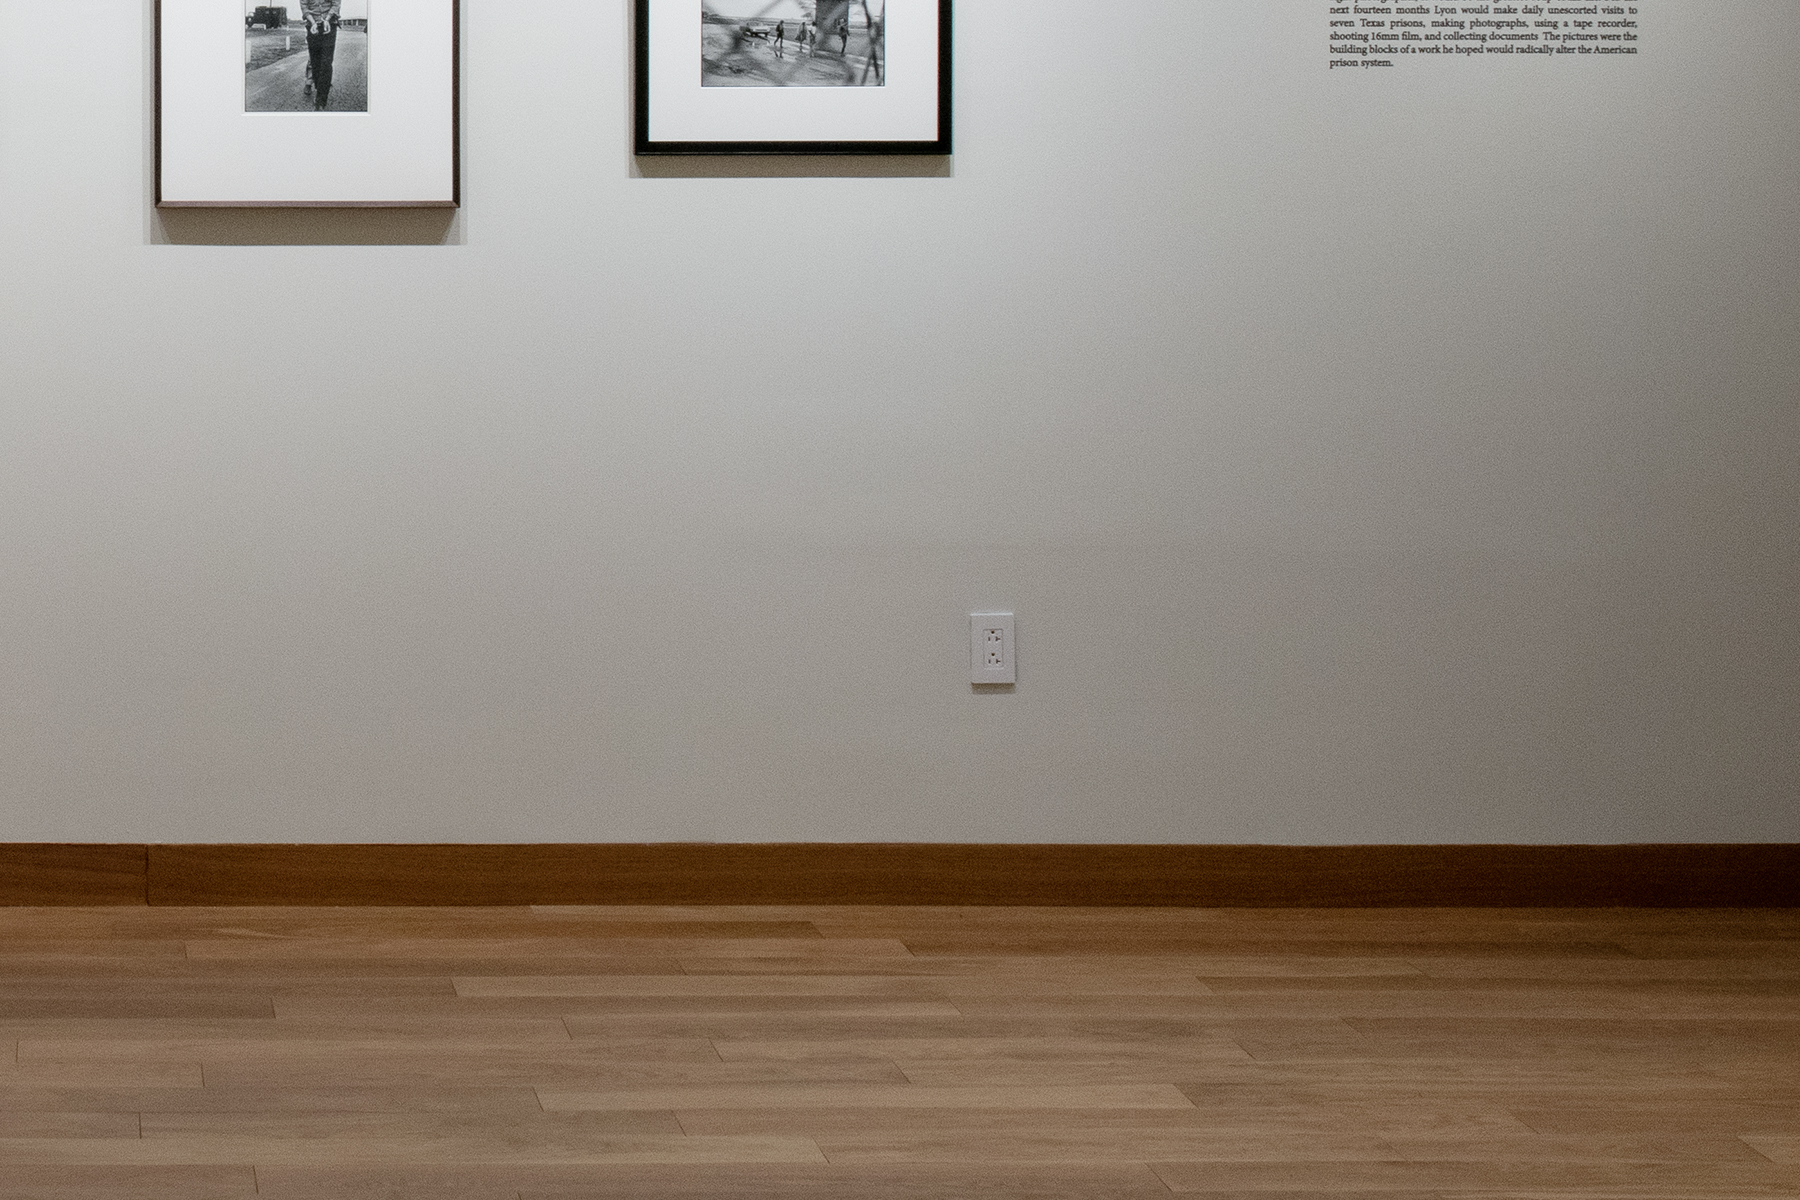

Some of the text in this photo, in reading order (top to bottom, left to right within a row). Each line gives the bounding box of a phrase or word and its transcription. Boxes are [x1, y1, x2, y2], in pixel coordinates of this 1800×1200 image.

[1329, 4, 1639, 17] next fourteen months Lyon would make daily unescorted visits to
[1329, 20, 1356, 28] seven
[1359, 17, 1386, 28] Texas
[1389, 18, 1426, 31] prisons,
[1430, 17, 1466, 31] making
[1469, 17, 1530, 31] photographs,
[1533, 18, 1559, 31] using
[1572, 19, 1594, 31] tape
[1597, 17, 1638, 29] recorder,
[1330, 30, 1369, 44] shooting
[1371, 31, 1399, 41] 16mm
[1402, 30, 1422, 42] film,
[1424, 30, 1441, 41] and
[1443, 30, 1487, 44] collecting
[1543, 30, 1561, 41] The
[1563, 31, 1598, 44] pictures
[1600, 33, 1621, 42] were
[1623, 31, 1638, 42] the
[1330, 43, 1368, 57] building
[1369, 43, 1398, 54] blocks
[1400, 43, 1411, 54] of
[1418, 44, 1441, 54] work
[1443, 43, 1454, 54] he
[1455, 43, 1484, 57] hoped
[1486, 43, 1514, 54] would
[1516, 44, 1554, 57] radically
[1556, 44, 1576, 54] alter
[1578, 44, 1592, 55] the
[1593, 44, 1637, 55] American
[1329, 57, 1395, 70] prison system.
